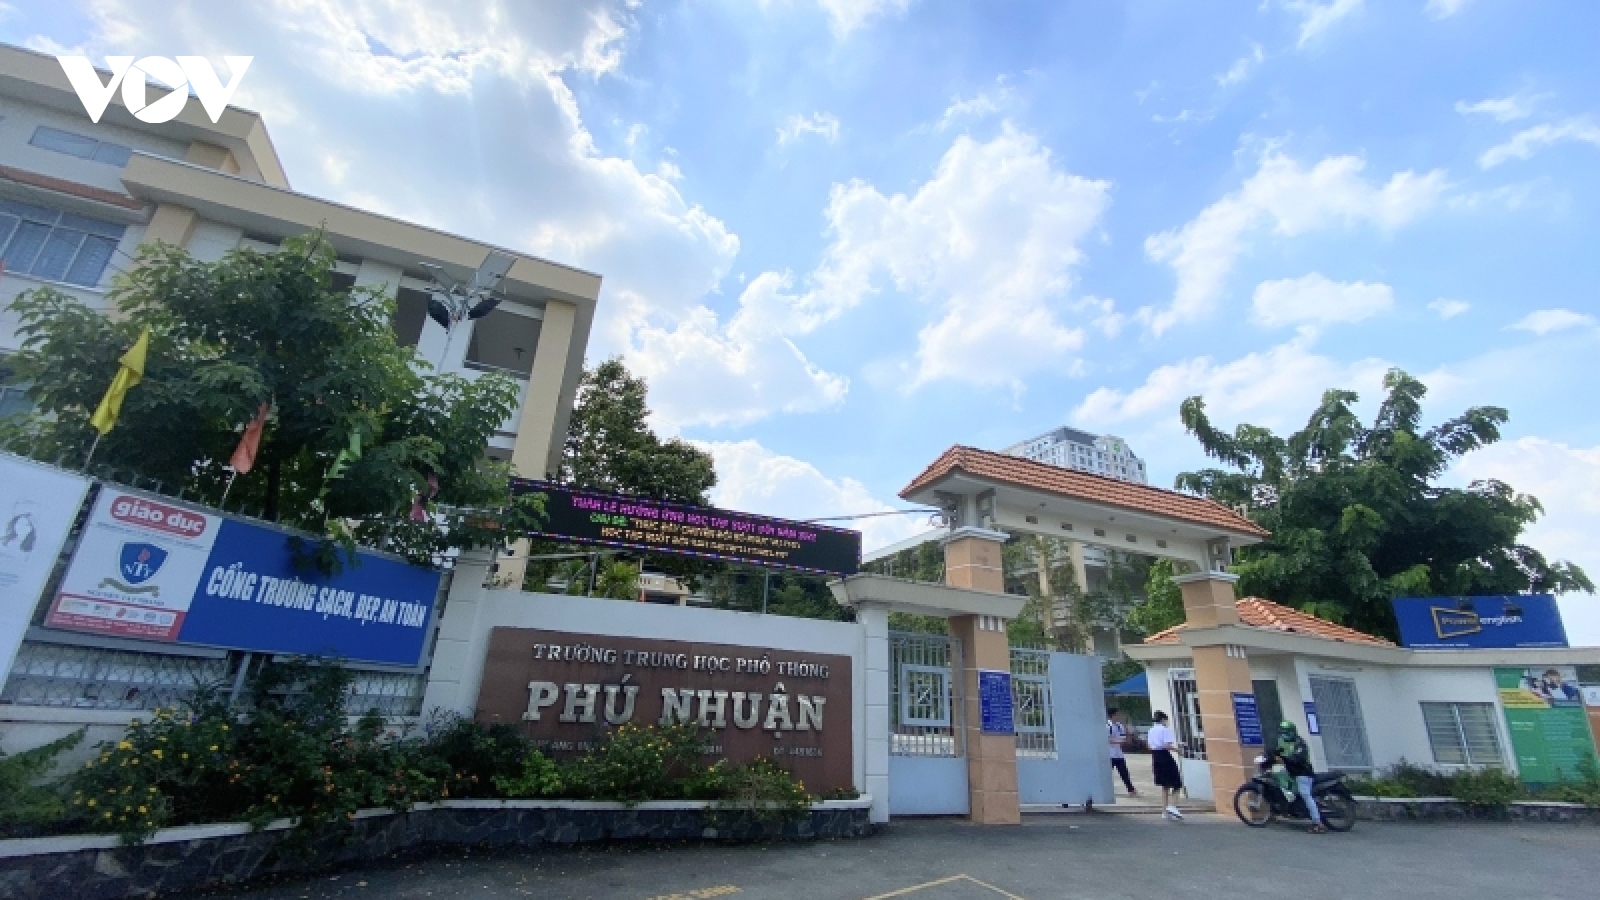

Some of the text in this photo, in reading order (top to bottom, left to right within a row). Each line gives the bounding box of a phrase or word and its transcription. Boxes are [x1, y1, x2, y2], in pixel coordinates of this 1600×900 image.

[206, 562, 257, 601] CỔNG
[256, 575, 318, 611] TRƯỜNG
[315, 586, 355, 620] SẠCH,
[377, 599, 399, 624] AN
[396, 600, 428, 628] TOÀN
[533, 642, 830, 679] TRƯỜNG TRUNG HỌC PHỔ THÔNG
[522, 674, 827, 739] PHÚ NHUẬN
